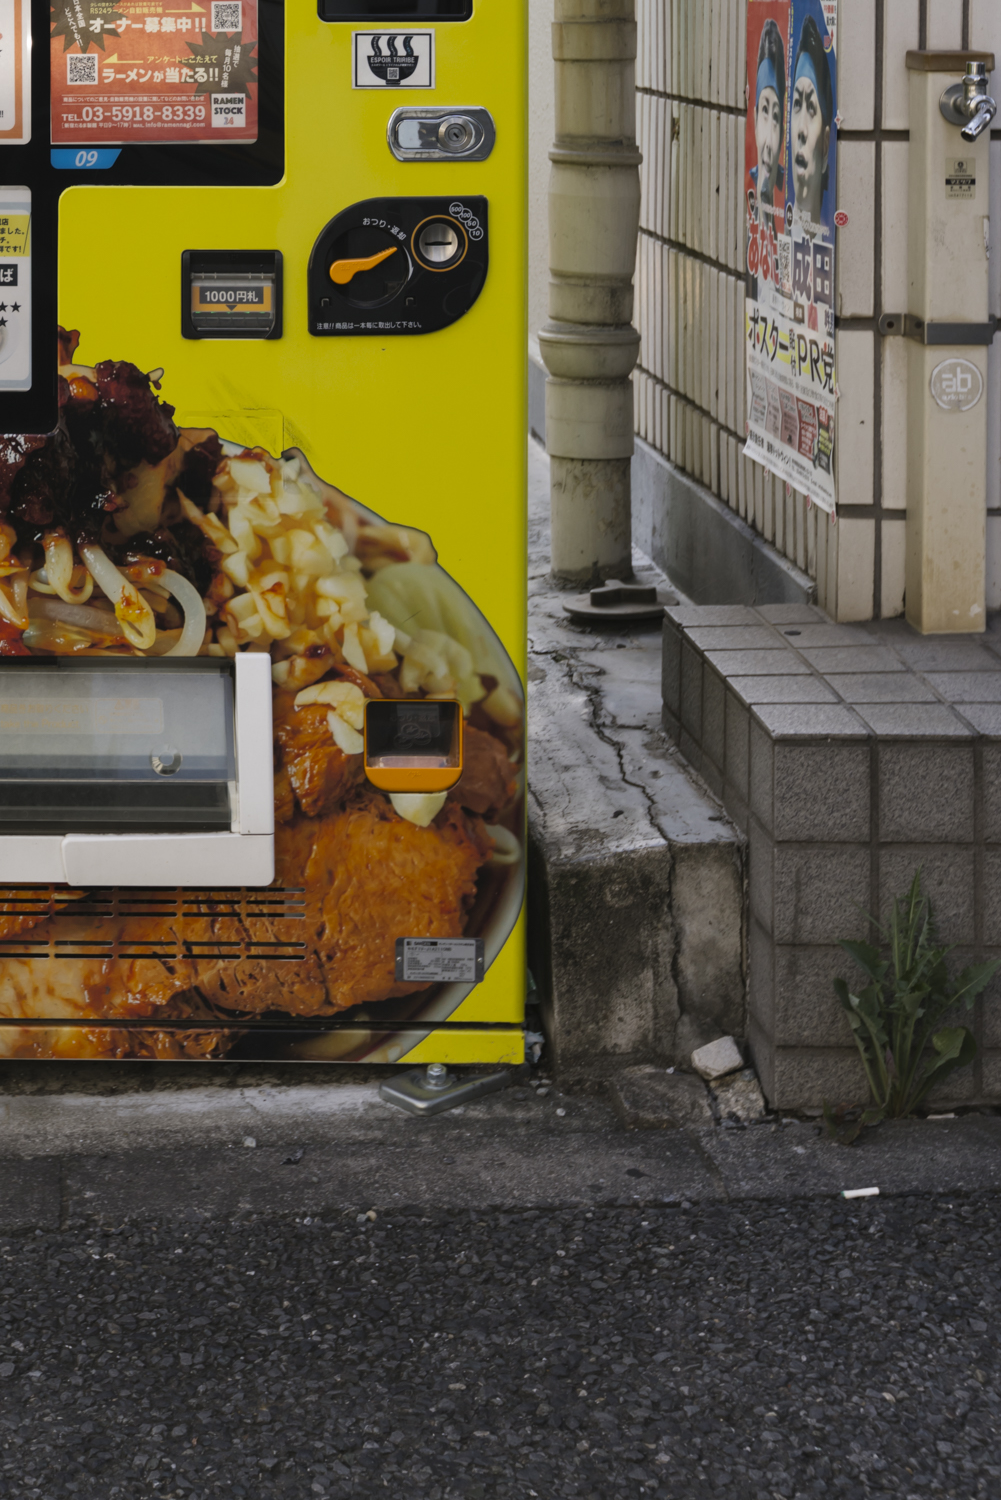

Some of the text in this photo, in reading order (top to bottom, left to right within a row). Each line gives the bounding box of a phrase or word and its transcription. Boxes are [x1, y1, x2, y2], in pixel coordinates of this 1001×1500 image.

[89, 17, 206, 33] オーナー募集中!!
[147, 56, 217, 64] アンケートにこたえて
[102, 68, 219, 83] ラーメンが当たる!!
[213, 97, 244, 105] RAMEN
[214, 107, 243, 115] STOCK
[224, 117, 234, 125] 24
[75, 151, 98, 167] 09
[205, 290, 258, 302] 1000円札
